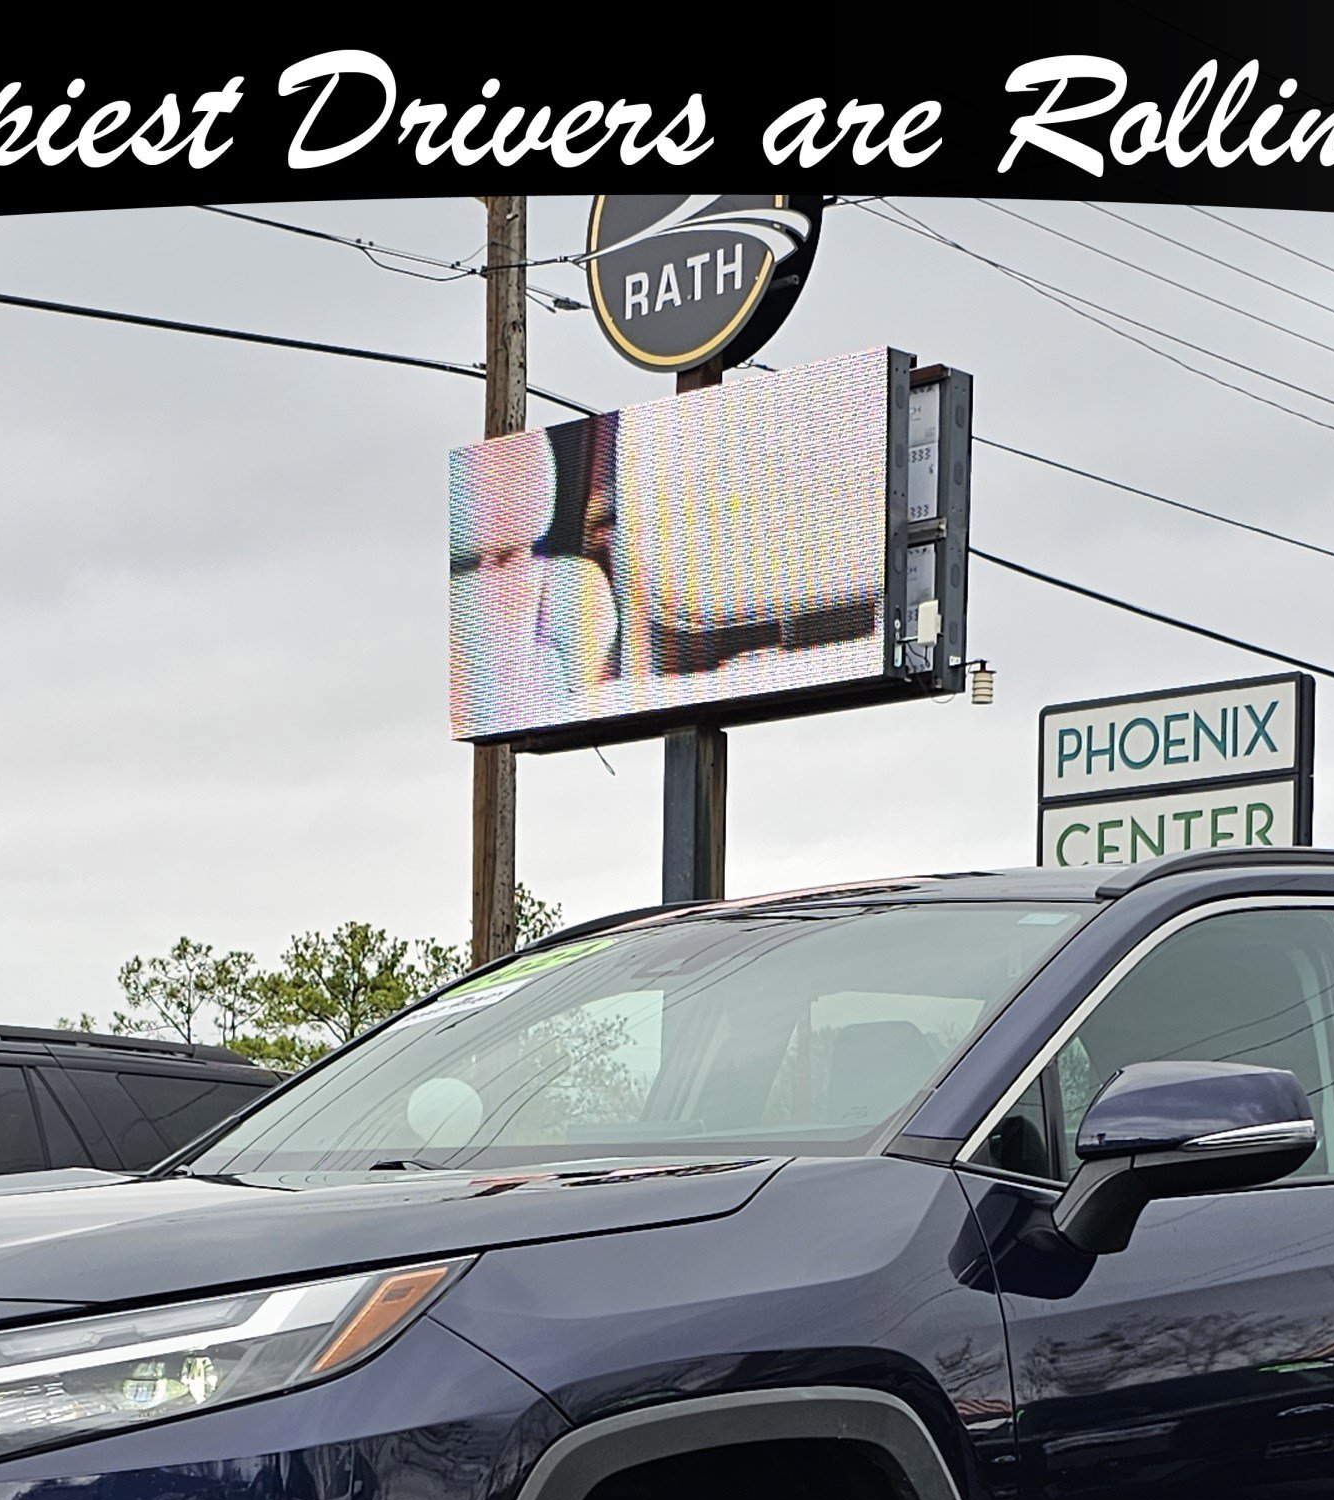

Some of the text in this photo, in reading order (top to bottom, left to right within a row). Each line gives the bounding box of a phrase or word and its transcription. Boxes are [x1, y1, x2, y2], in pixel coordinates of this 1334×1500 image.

[625, 243, 743, 320] RATH
[1058, 700, 1279, 778] PHOENIX
[1056, 803, 1274, 866] CENTER
